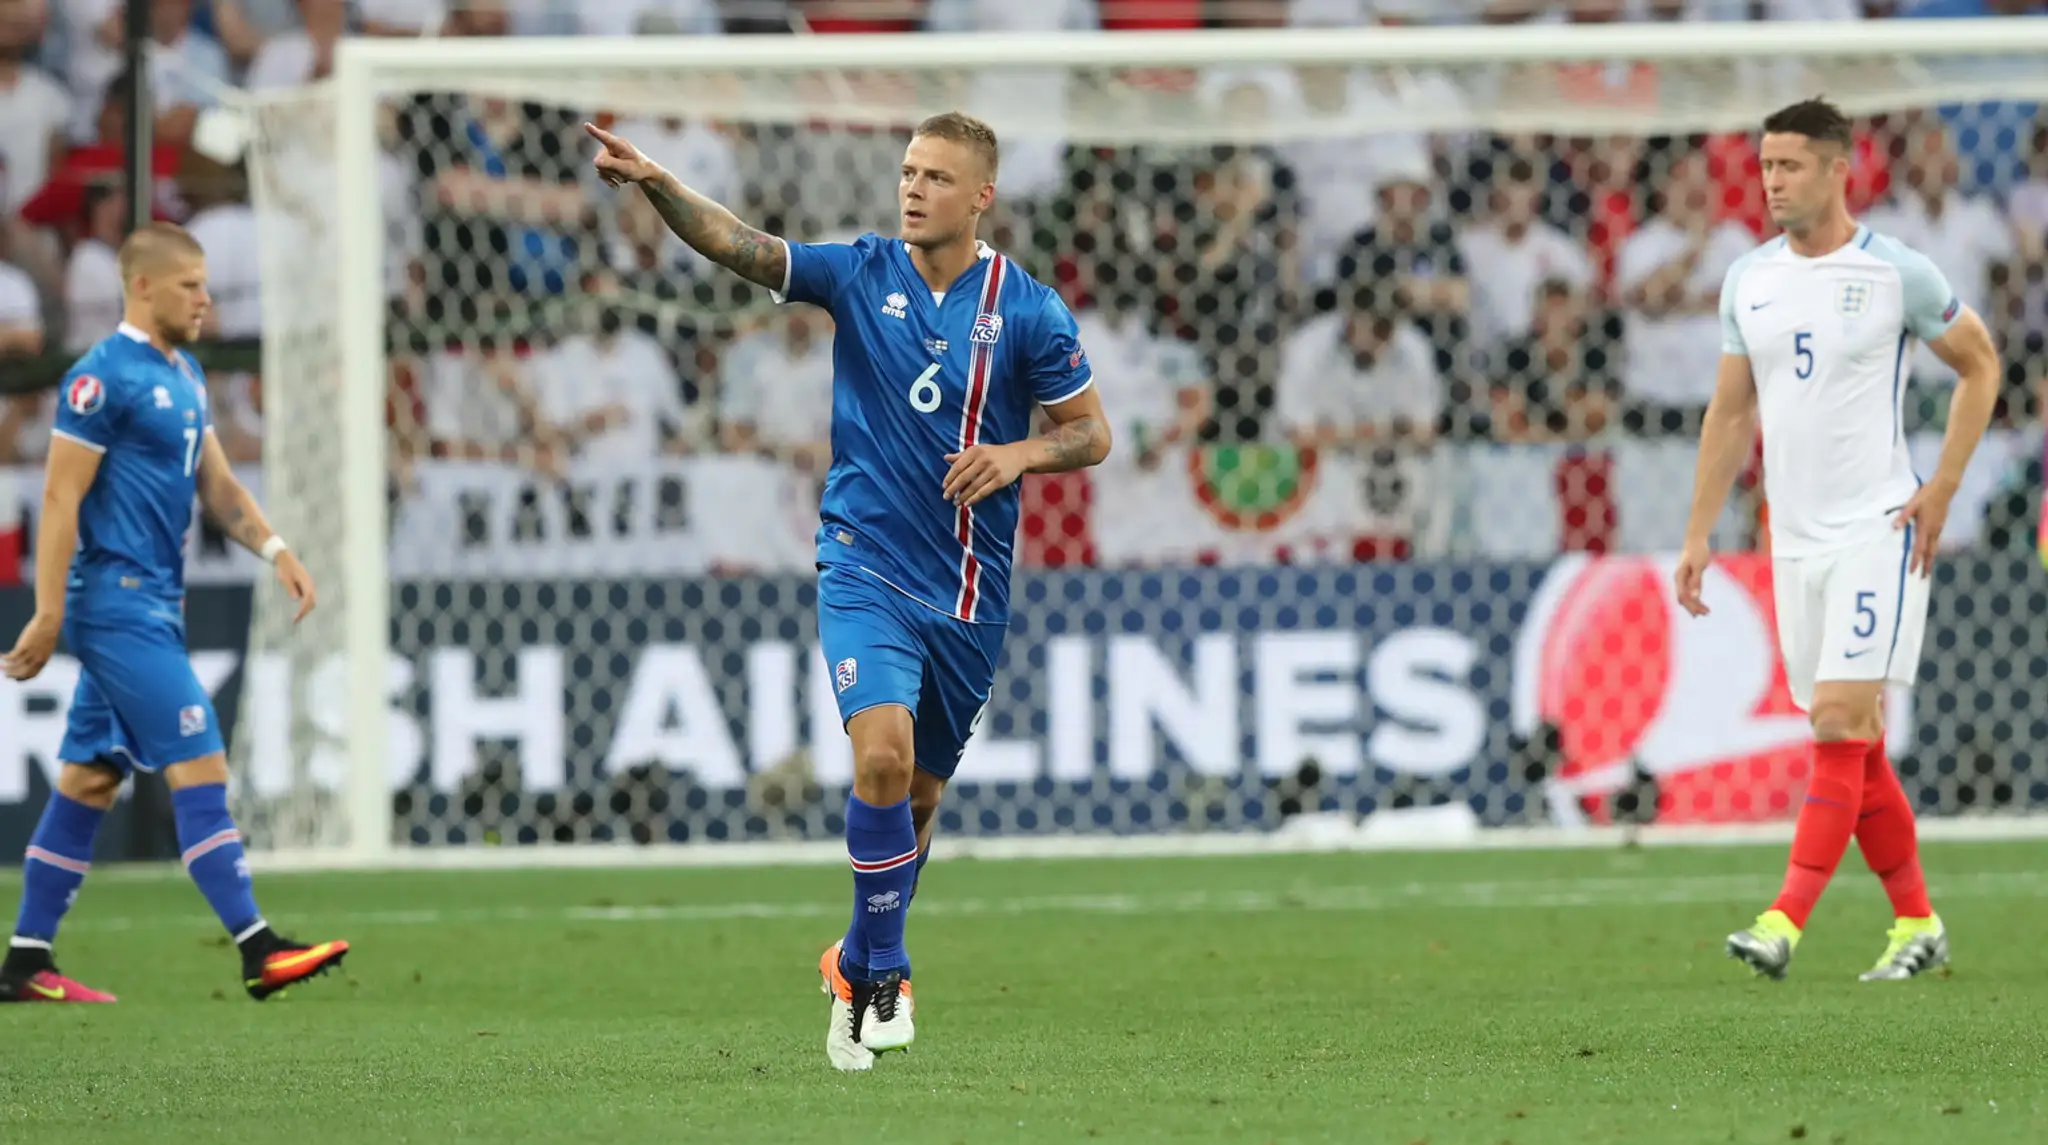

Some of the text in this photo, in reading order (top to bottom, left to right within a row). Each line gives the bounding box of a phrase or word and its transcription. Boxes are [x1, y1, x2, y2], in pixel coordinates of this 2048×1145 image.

[1794, 332, 1814, 380] 5
[909, 362, 942, 413] 6
[183, 428, 198, 477] 7
[1853, 591, 1876, 638] 5
